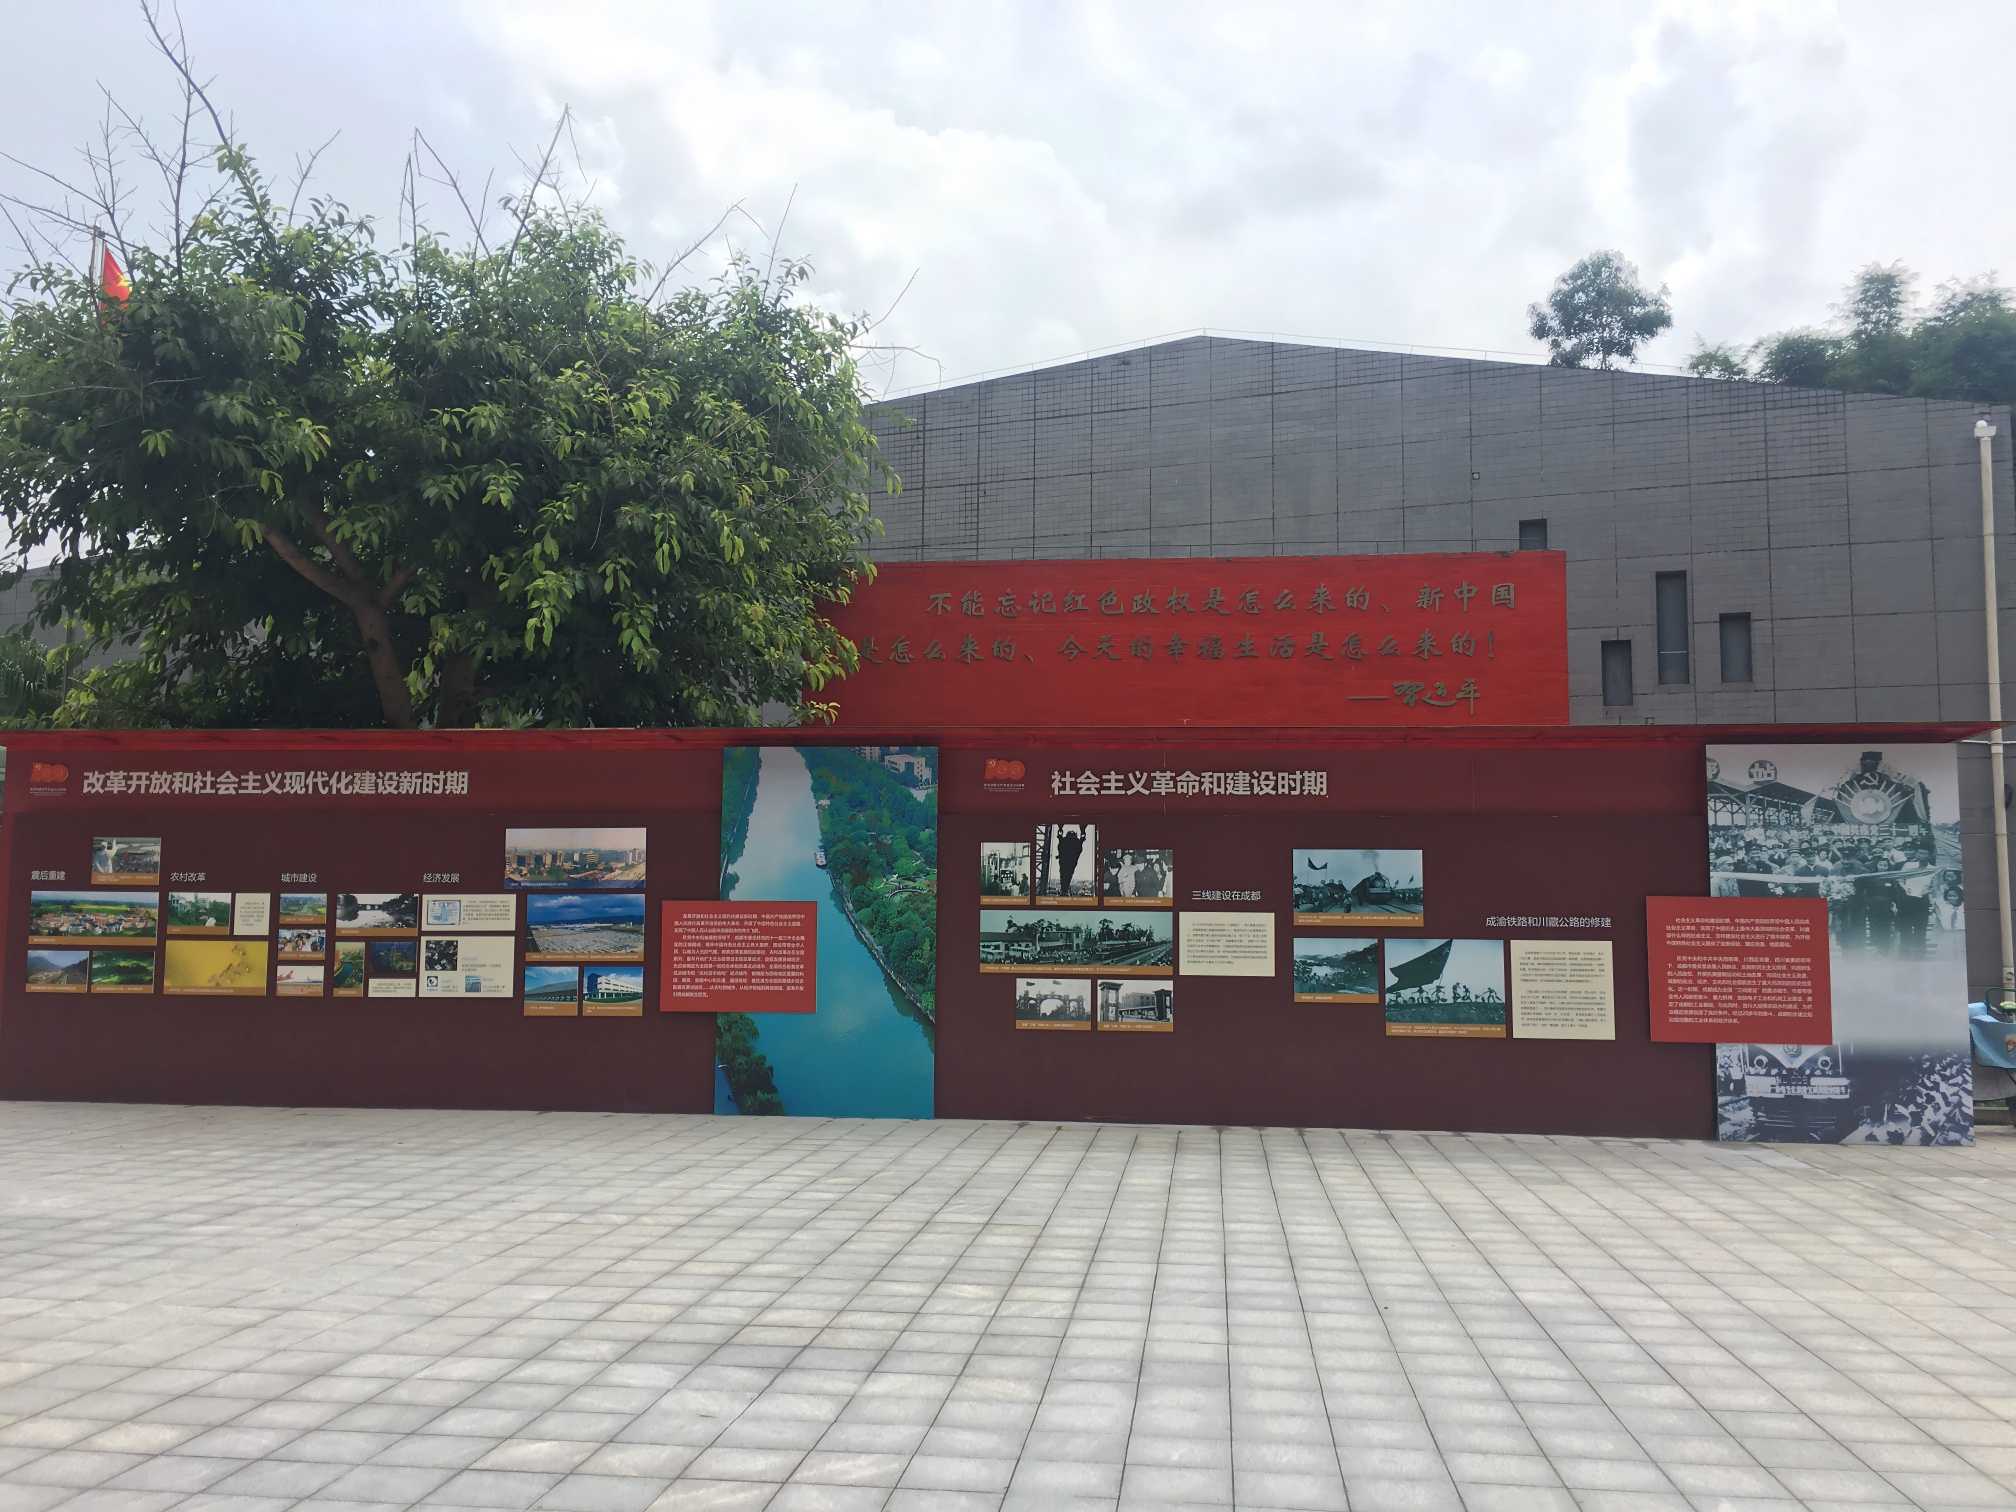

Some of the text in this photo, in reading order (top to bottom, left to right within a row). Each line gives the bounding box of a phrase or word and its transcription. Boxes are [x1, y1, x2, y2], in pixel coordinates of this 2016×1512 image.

[82, 770, 469, 796] 改革开放和社会主义现代化建设新时期
[1051, 770, 1328, 796] 社会主义革命和建设时期
[169, 871, 206, 882] 农村改革
[281, 872, 318, 883] 城市建设
[423, 872, 460, 883] 经济发展
[1191, 890, 1261, 901] 三线建设在成都
[1485, 917, 1612, 928] 成渝铁路和川藏公路的修建
